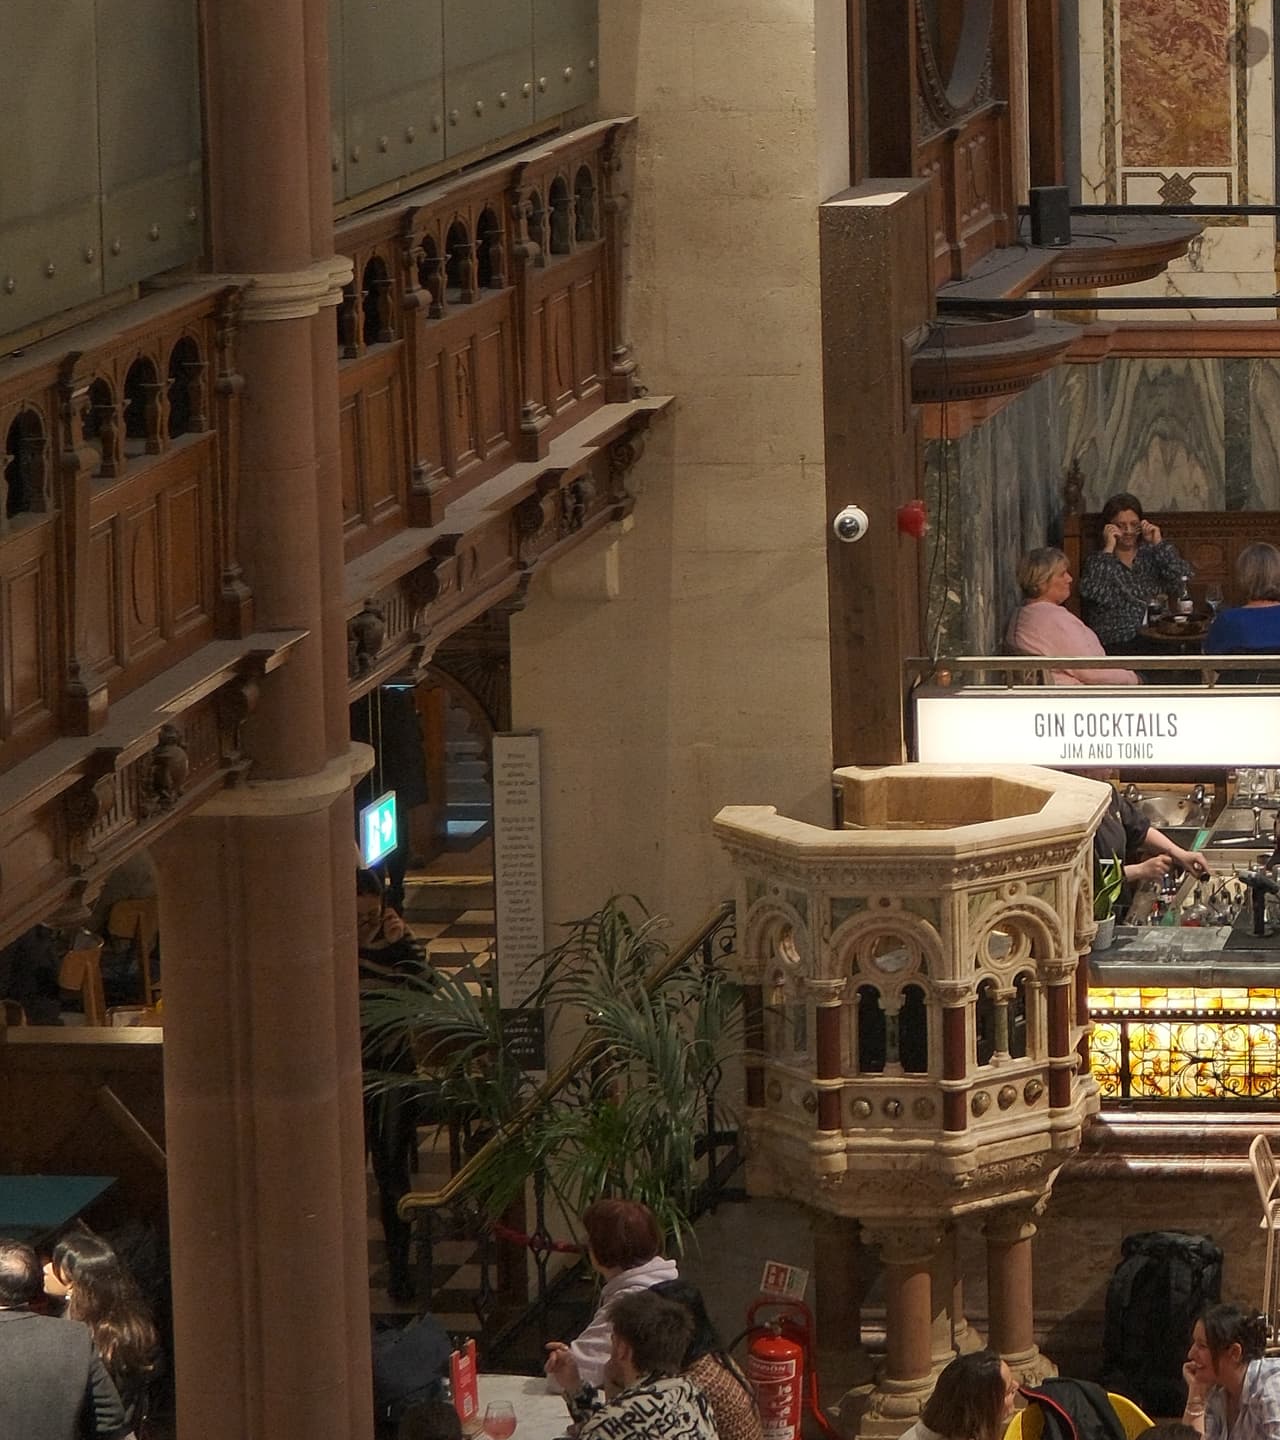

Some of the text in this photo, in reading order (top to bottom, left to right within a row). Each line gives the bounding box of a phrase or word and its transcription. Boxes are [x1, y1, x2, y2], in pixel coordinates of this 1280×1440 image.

[1034, 712, 1178, 737] GIN COCKTAILS
[1060, 743, 1154, 760] JIM AND TONIC
[599, 1397, 667, 1440] THRILL
